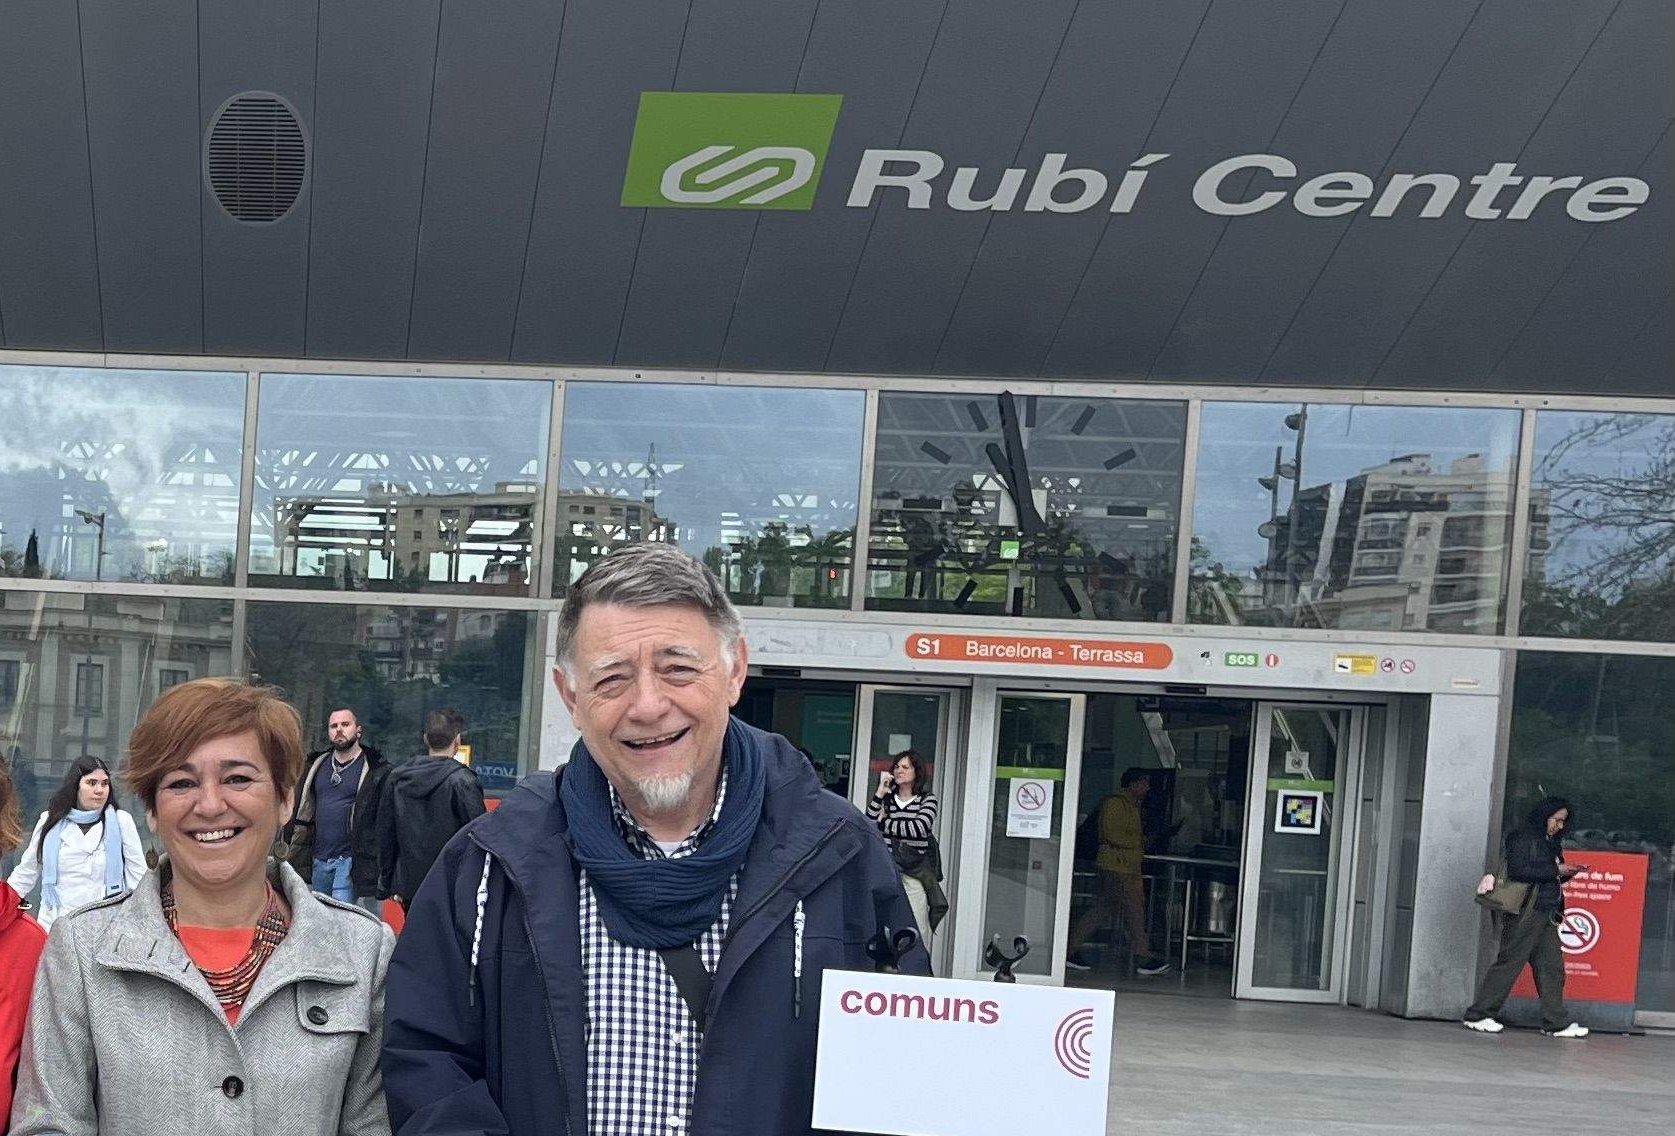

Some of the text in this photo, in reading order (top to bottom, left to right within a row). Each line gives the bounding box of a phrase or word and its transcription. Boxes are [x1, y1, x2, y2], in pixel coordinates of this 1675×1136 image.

[846, 150, 1650, 222] Rubí Centre
[916, 637, 941, 655] S1
[966, 640, 1054, 659] Barcelona
[1069, 644, 1145, 664] Terrassa
[1228, 654, 1256, 665] SOS
[840, 990, 999, 1024] comuns
